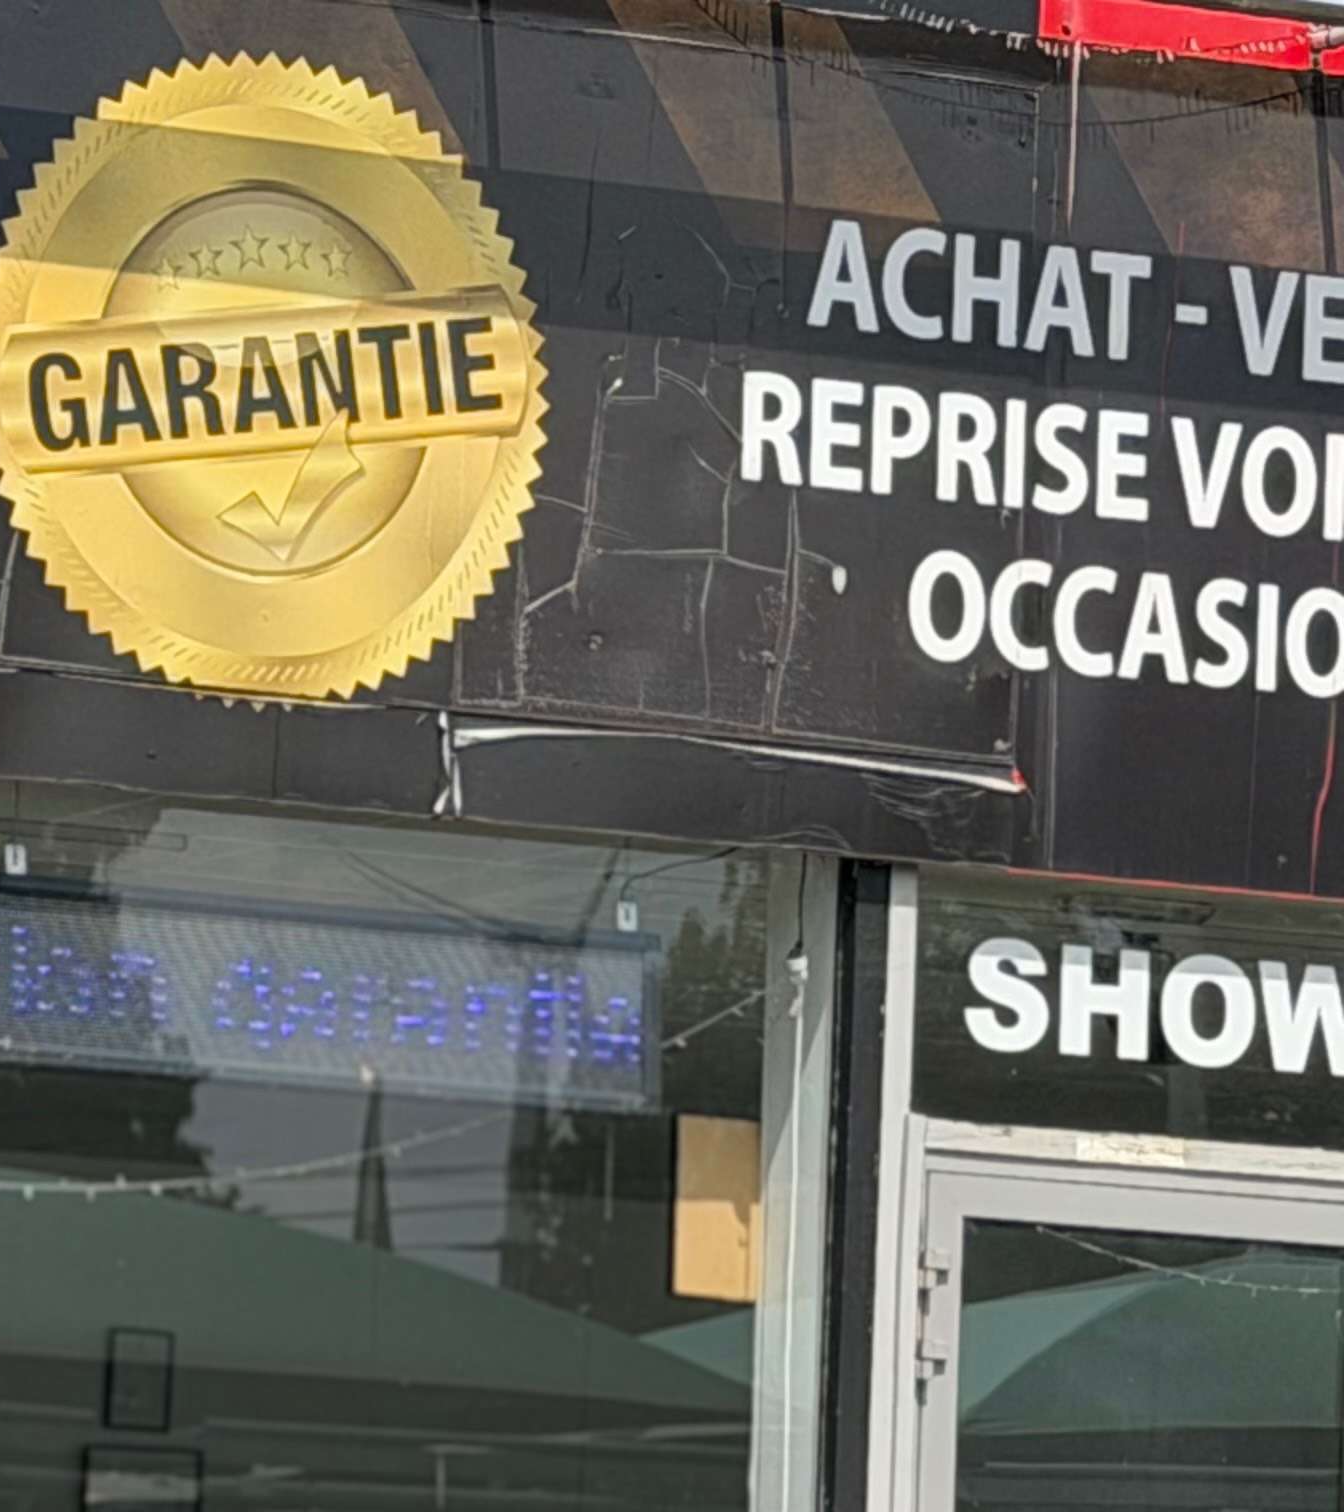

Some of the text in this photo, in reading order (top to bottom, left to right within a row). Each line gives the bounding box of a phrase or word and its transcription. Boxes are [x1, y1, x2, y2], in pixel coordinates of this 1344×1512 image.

[807, 218, 1152, 360] ACHAT
[1229, 265, 1344, 384] VE
[26, 316, 503, 453] GARANTIE
[740, 370, 1150, 522] REPRISE
[908, 549, 1344, 699] OCCASIO
[963, 937, 1344, 1077] SHOW
